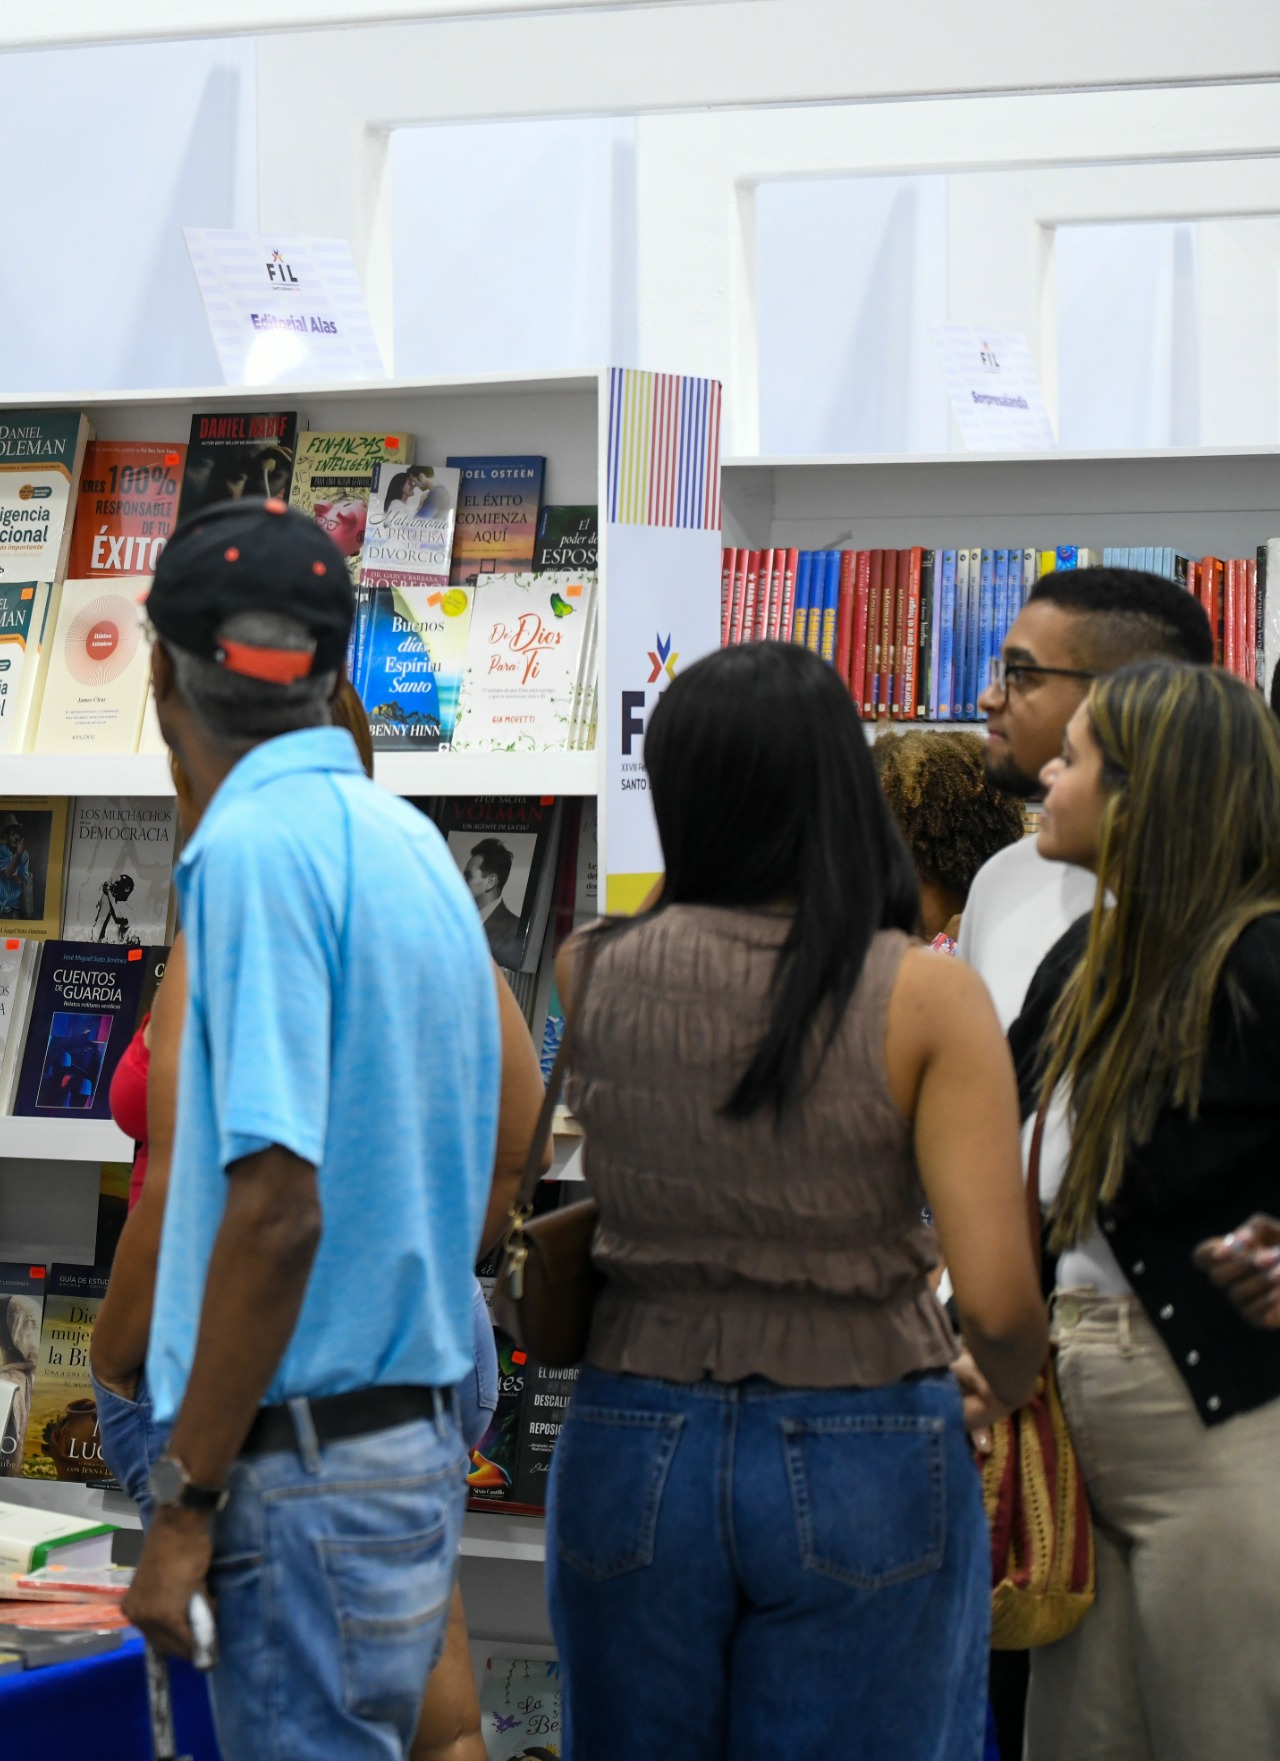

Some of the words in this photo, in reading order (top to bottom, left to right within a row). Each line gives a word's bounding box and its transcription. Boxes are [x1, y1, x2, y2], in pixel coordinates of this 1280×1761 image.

[266, 263, 299, 282] FIL
[251, 314, 307, 332] Editorial
[311, 317, 337, 334] Alas
[980, 352, 999, 367] FIL
[199, 418, 244, 438] DANIEL
[249, 416, 287, 438] HABIF
[306, 437, 385, 456] FINANZAS
[82, 480, 105, 493] ERES
[108, 465, 176, 496] 100%
[460, 470, 486, 479] JOEL
[491, 469, 535, 478] OSTEEN
[464, 494, 480, 507] EL
[482, 492, 523, 506] ÉXITO
[96, 500, 172, 517] RESPONSABLE
[369, 509, 449, 530] Matrimonio
[456, 513, 528, 524] COMIENZA
[578, 518, 589, 531] El
[142, 522, 154, 534] DE
[158, 522, 170, 535] TU
[372, 528, 381, 538] A
[388, 528, 445, 544] PRUEBA
[473, 528, 507, 543] AQUÍ
[91, 525, 168, 571] ÉXITO
[559, 534, 585, 548] poder
[369, 547, 445, 564] DIVORCIO
[883, 588, 891, 627] MÁQUINAS
[392, 617, 444, 632] Buenos
[907, 618, 914, 627] el
[509, 612, 564, 653] Dios
[822, 608, 835, 661] CAMIONES
[907, 627, 915, 646] para
[384, 656, 442, 677] Espíritu
[905, 647, 913, 682] prácticas
[388, 677, 432, 694] Santo
[903, 683, 911, 713] Mejoras
[492, 715, 503, 724] GIA
[504, 715, 535, 724] MORETTI
[369, 724, 408, 737] BENNY
[410, 725, 441, 737] HINN
[621, 779, 647, 791] SANTO
[80, 809, 100, 819] LOS
[102, 809, 172, 822] MUCHACHOS
[454, 804, 543, 821] VOLMAN
[79, 826, 169, 841] DEMOCRACIA
[53, 969, 116, 986] CUENTOS
[63, 985, 122, 1002] GUARDIA
[517, 1696, 543, 1715] La
